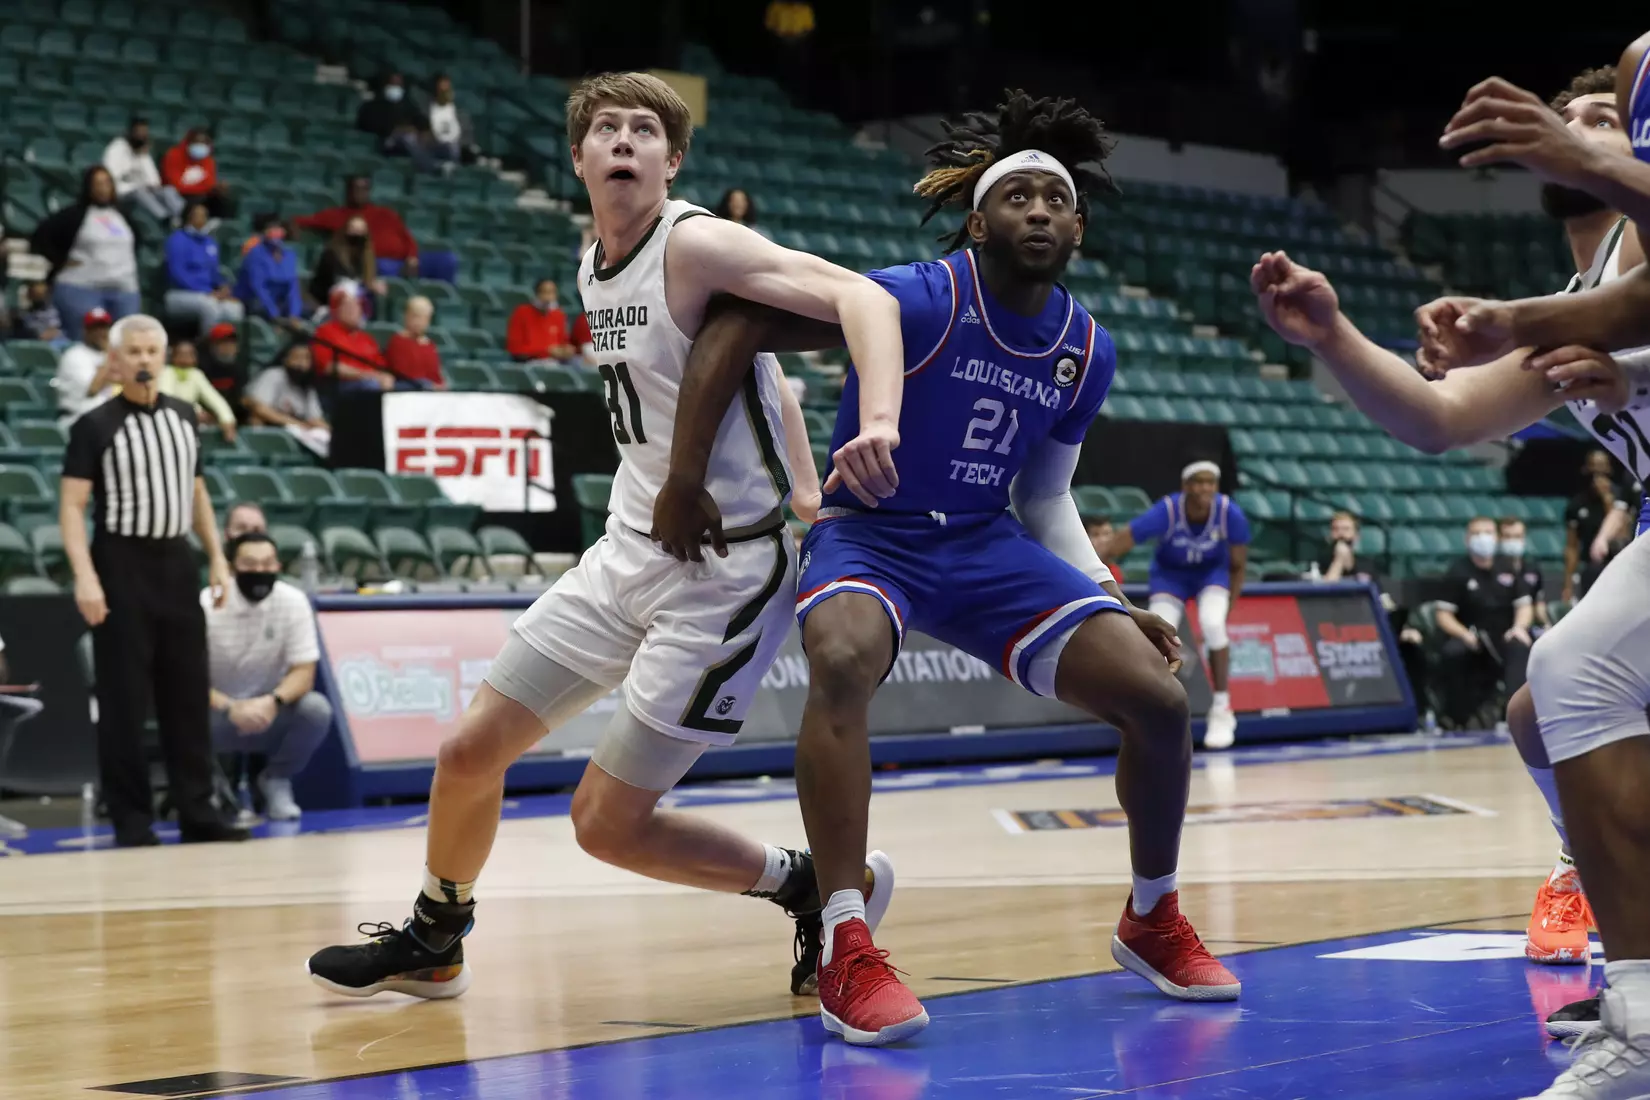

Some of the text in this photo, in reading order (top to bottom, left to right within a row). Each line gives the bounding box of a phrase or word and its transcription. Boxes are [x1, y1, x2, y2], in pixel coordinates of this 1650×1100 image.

[586, 306, 648, 330] OLORADO
[599, 362, 647, 444] 31
[950, 356, 1061, 409] LOUISIANA
[962, 397, 1018, 455] 21
[397, 427, 542, 479] ESPN
[950, 460, 1006, 486] TECH
[884, 649, 991, 683] ITATION
